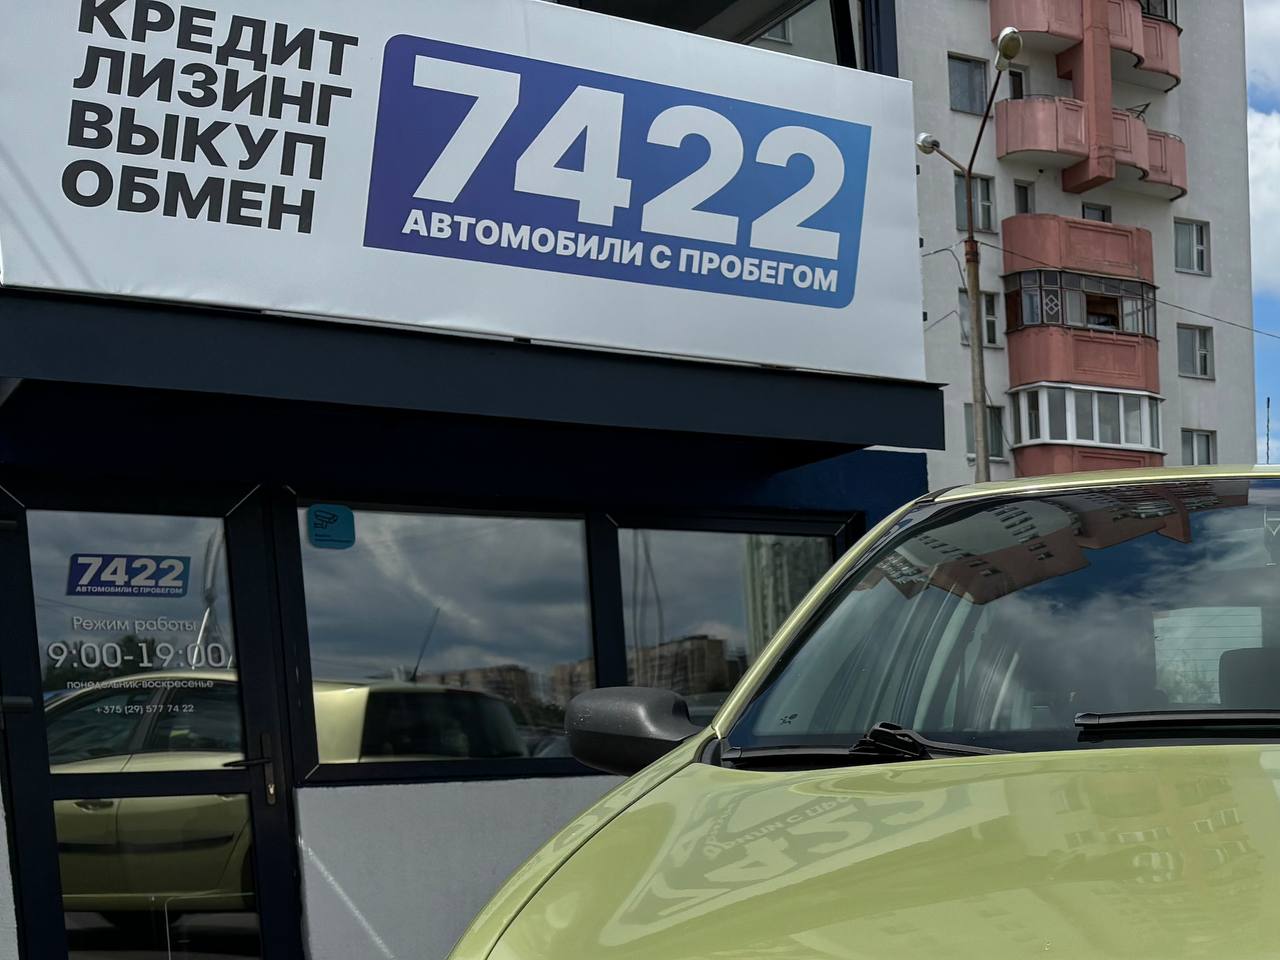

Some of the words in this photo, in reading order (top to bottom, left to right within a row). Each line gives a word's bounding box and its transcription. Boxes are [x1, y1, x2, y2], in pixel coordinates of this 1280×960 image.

[78, 0, 359, 76] КРЕДИТ
[73, 45, 353, 127] ЛИЗИНГ
[67, 98, 327, 181] ВЫКУП
[412, 54, 846, 261] 7422
[61, 158, 316, 235] ОБМЕН
[401, 208, 644, 266] АВТОМОБИЛИ
[649, 246, 674, 270] С
[678, 248, 838, 293] ПРОБЕГОМ
[75, 586, 132, 594] АВТОМОБИЛИ
[77, 556, 184, 587] 7422
[48, 642, 226, 669] 9:00-19:00
[72, 616, 131, 632] Режим
[135, 616, 199, 634] работы
[95, 705, 122, 714] +375
[124, 705, 144, 715] (29)
[146, 705, 163, 713] 577
[166, 704, 180, 713] 74
[182, 704, 195, 713] 22
